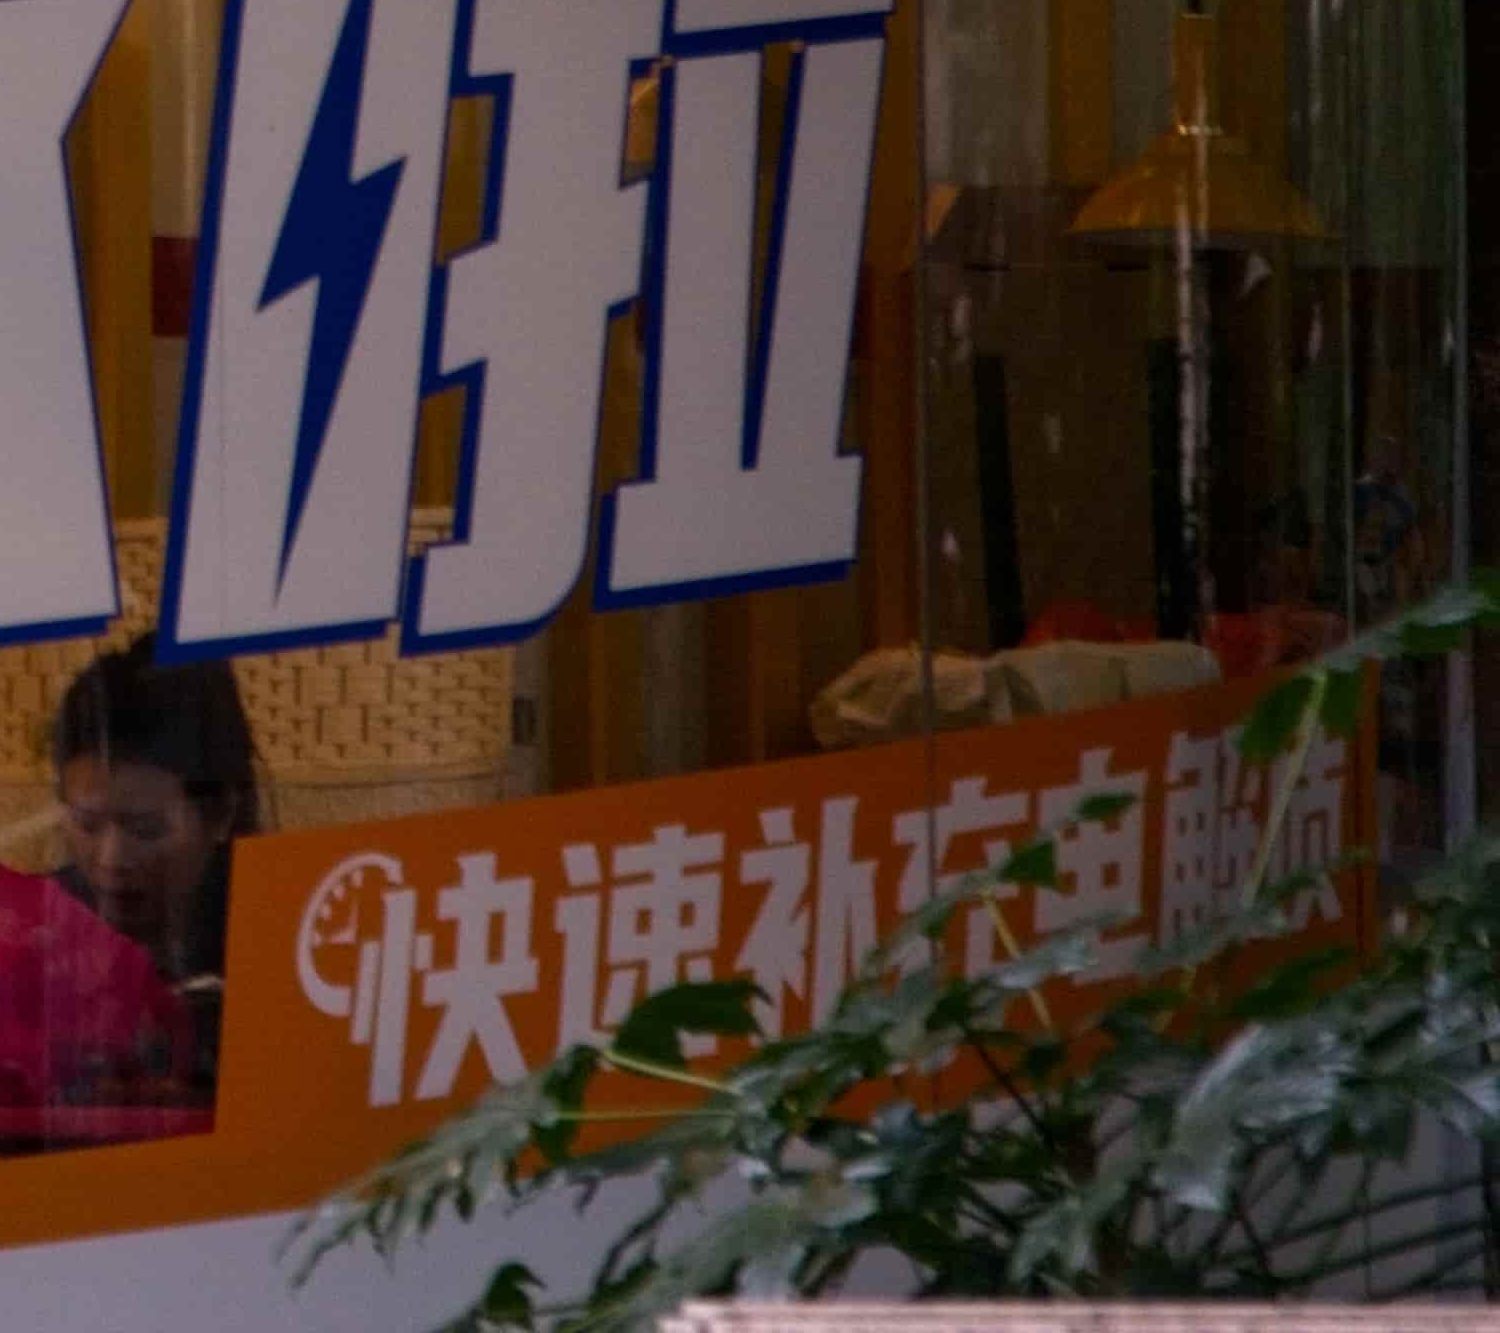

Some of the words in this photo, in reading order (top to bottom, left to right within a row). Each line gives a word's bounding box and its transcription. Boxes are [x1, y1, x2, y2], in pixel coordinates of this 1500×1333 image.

[348, 731, 1346, 1109] 快速补充电解质
